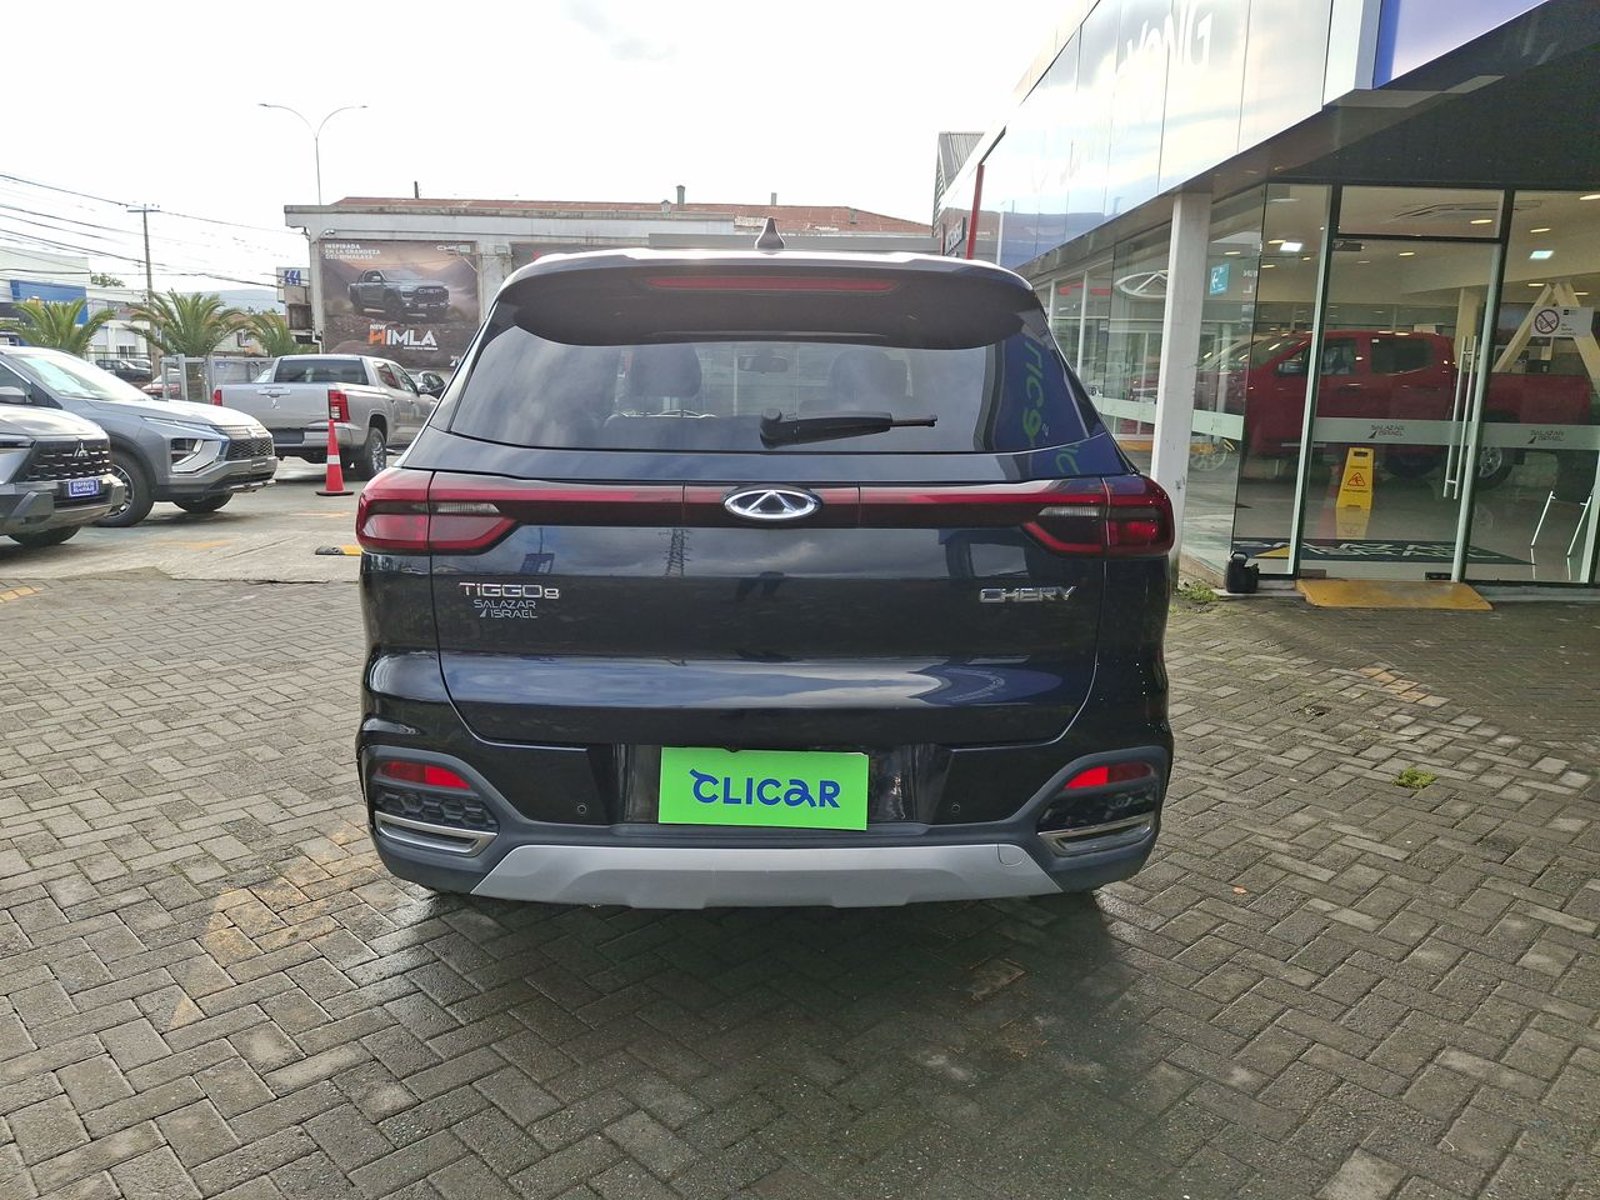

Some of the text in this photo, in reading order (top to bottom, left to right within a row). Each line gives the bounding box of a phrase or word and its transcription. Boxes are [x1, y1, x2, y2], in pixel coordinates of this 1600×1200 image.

[369, 329, 438, 347] HIMLA
[979, 586, 1077, 603] CHERY
[473, 599, 536, 609] SALAZAR
[490, 608, 538, 619] ISRAEL
